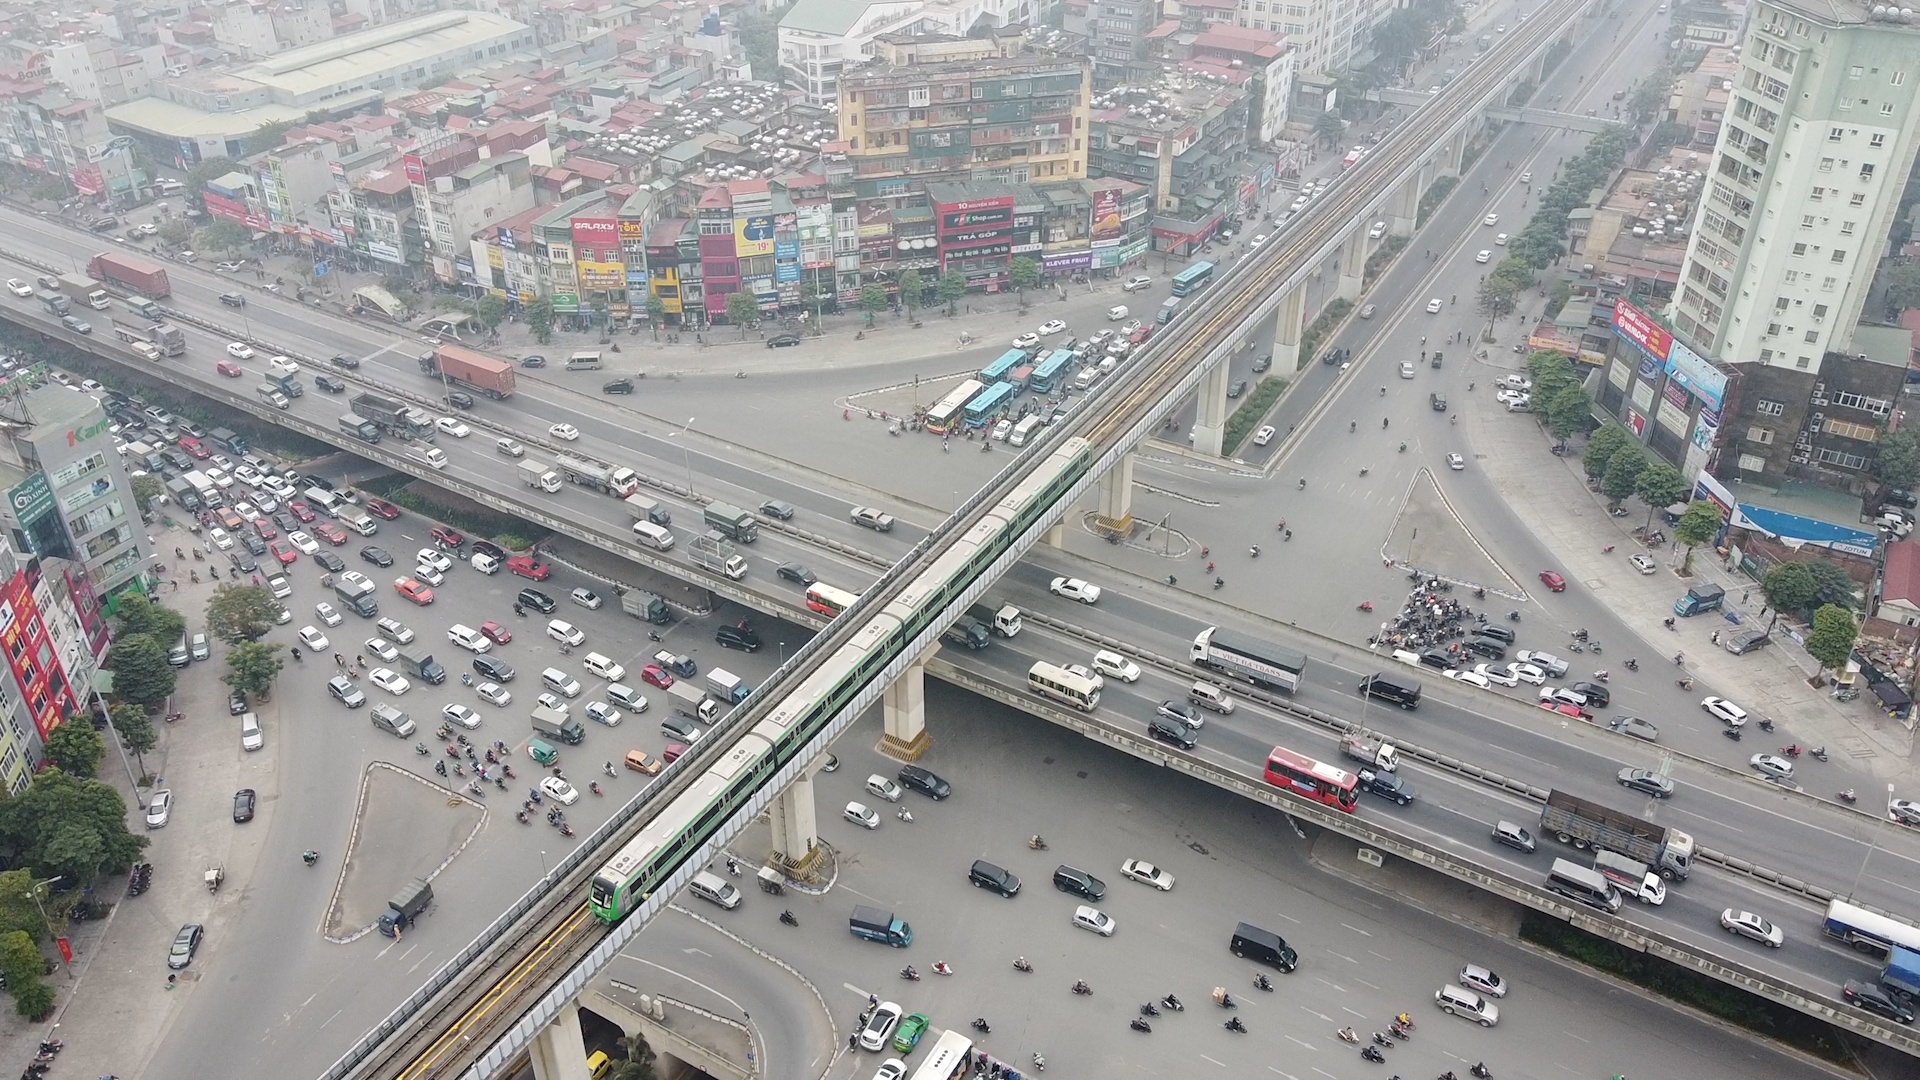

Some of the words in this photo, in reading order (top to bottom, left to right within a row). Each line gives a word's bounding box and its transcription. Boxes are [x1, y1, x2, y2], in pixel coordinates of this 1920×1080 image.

[958, 202, 968, 210] 10
[574, 222, 615, 230] GALAXY
[1046, 259, 1070, 267] KLEVER
[1071, 256, 1090, 264] FRUIT
[1844, 545, 1868, 555] JOTUN
